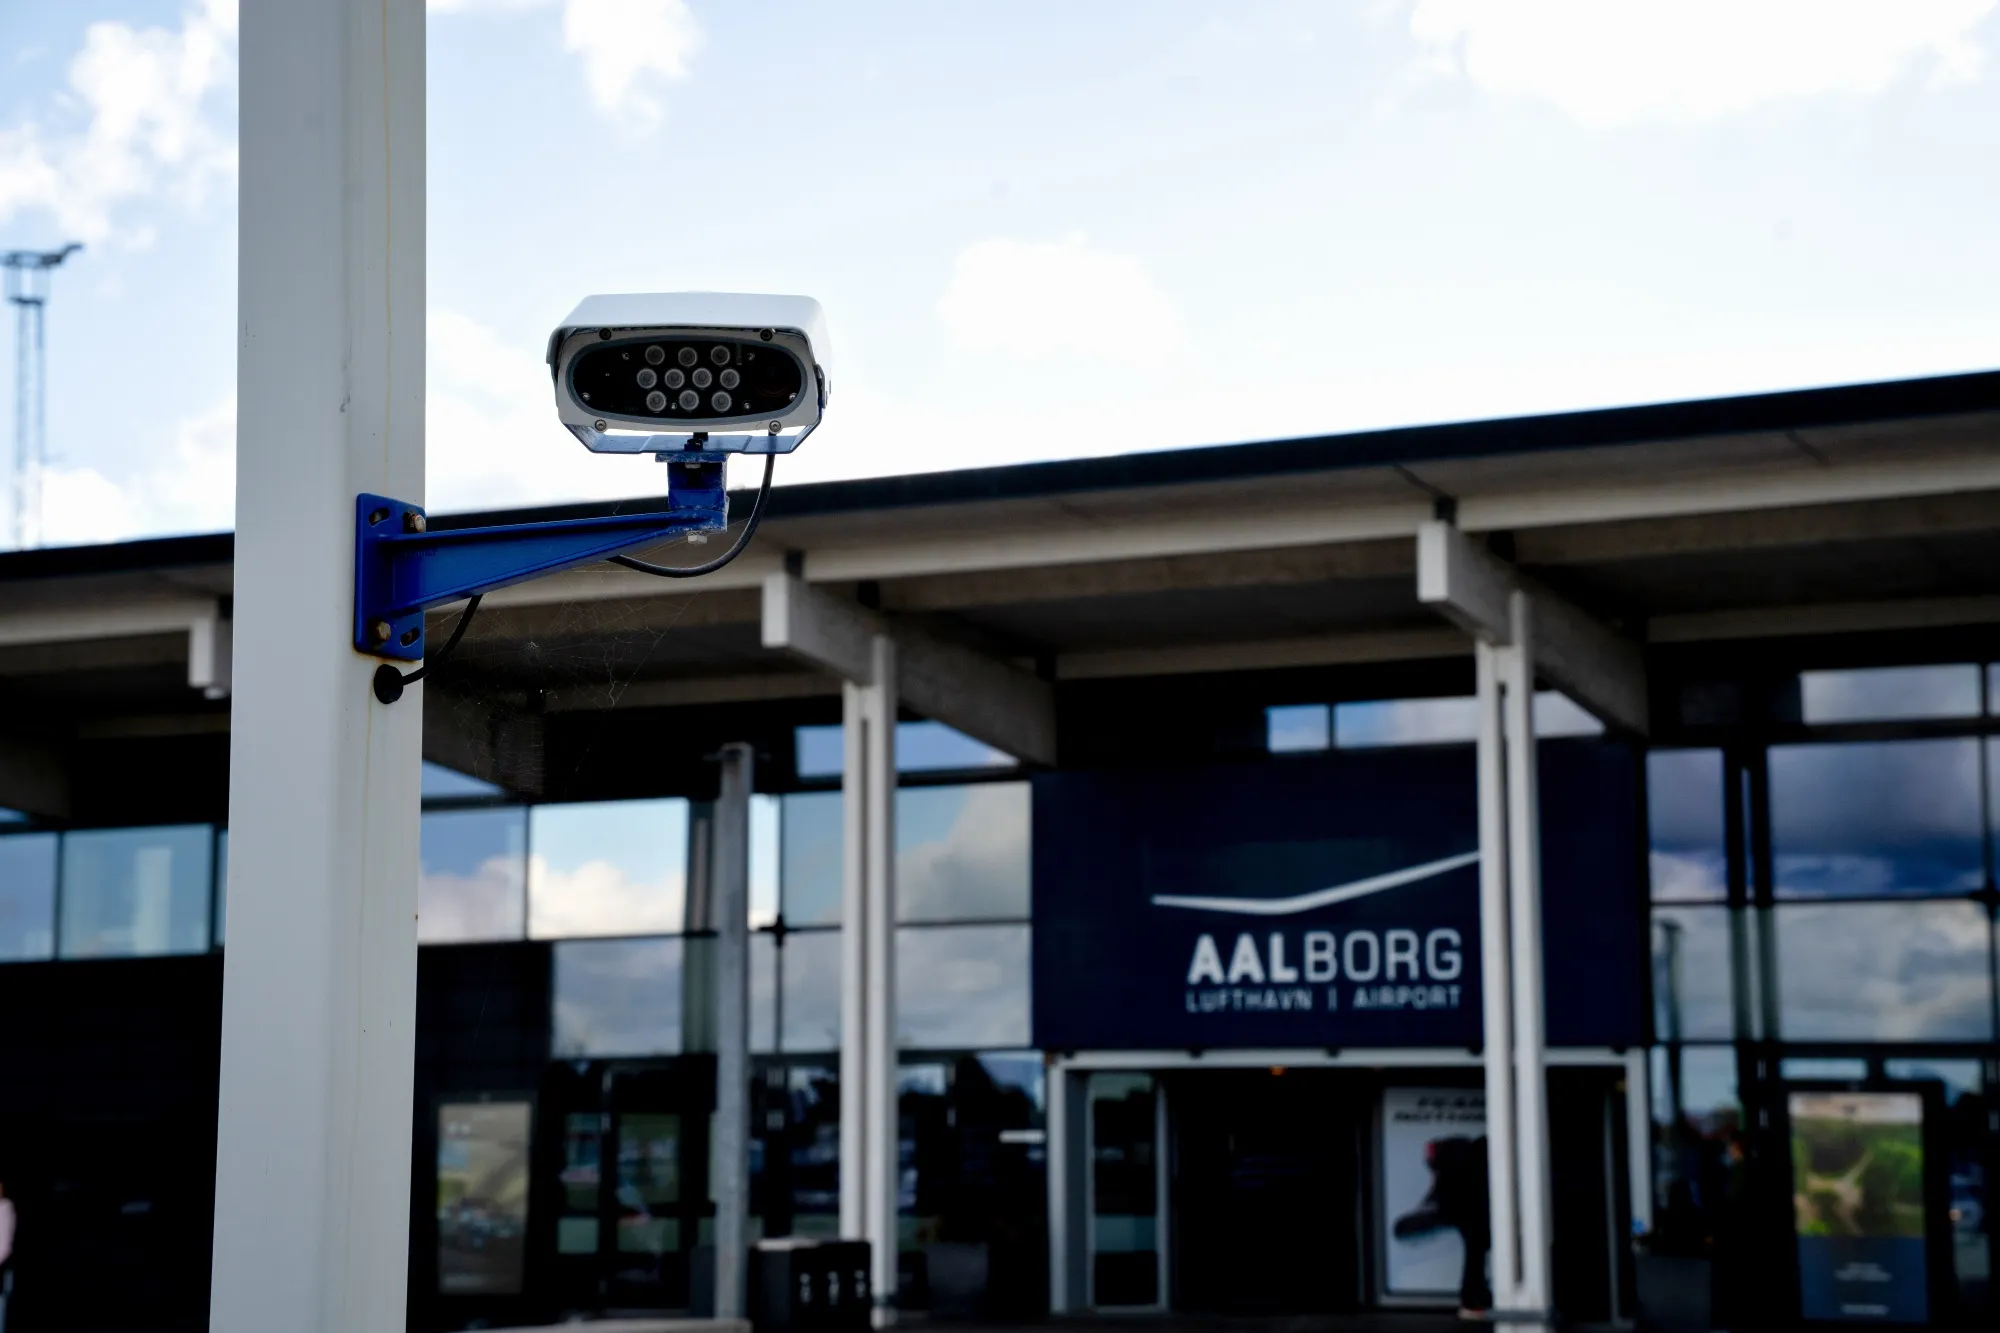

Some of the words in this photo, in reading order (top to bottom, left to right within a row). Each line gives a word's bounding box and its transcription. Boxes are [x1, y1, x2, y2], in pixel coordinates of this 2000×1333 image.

[1187, 928, 1463, 985] AALBORG
[1185, 987, 1313, 1013] LUFTHAVN
[1353, 985, 1461, 1010] AIRPORT
